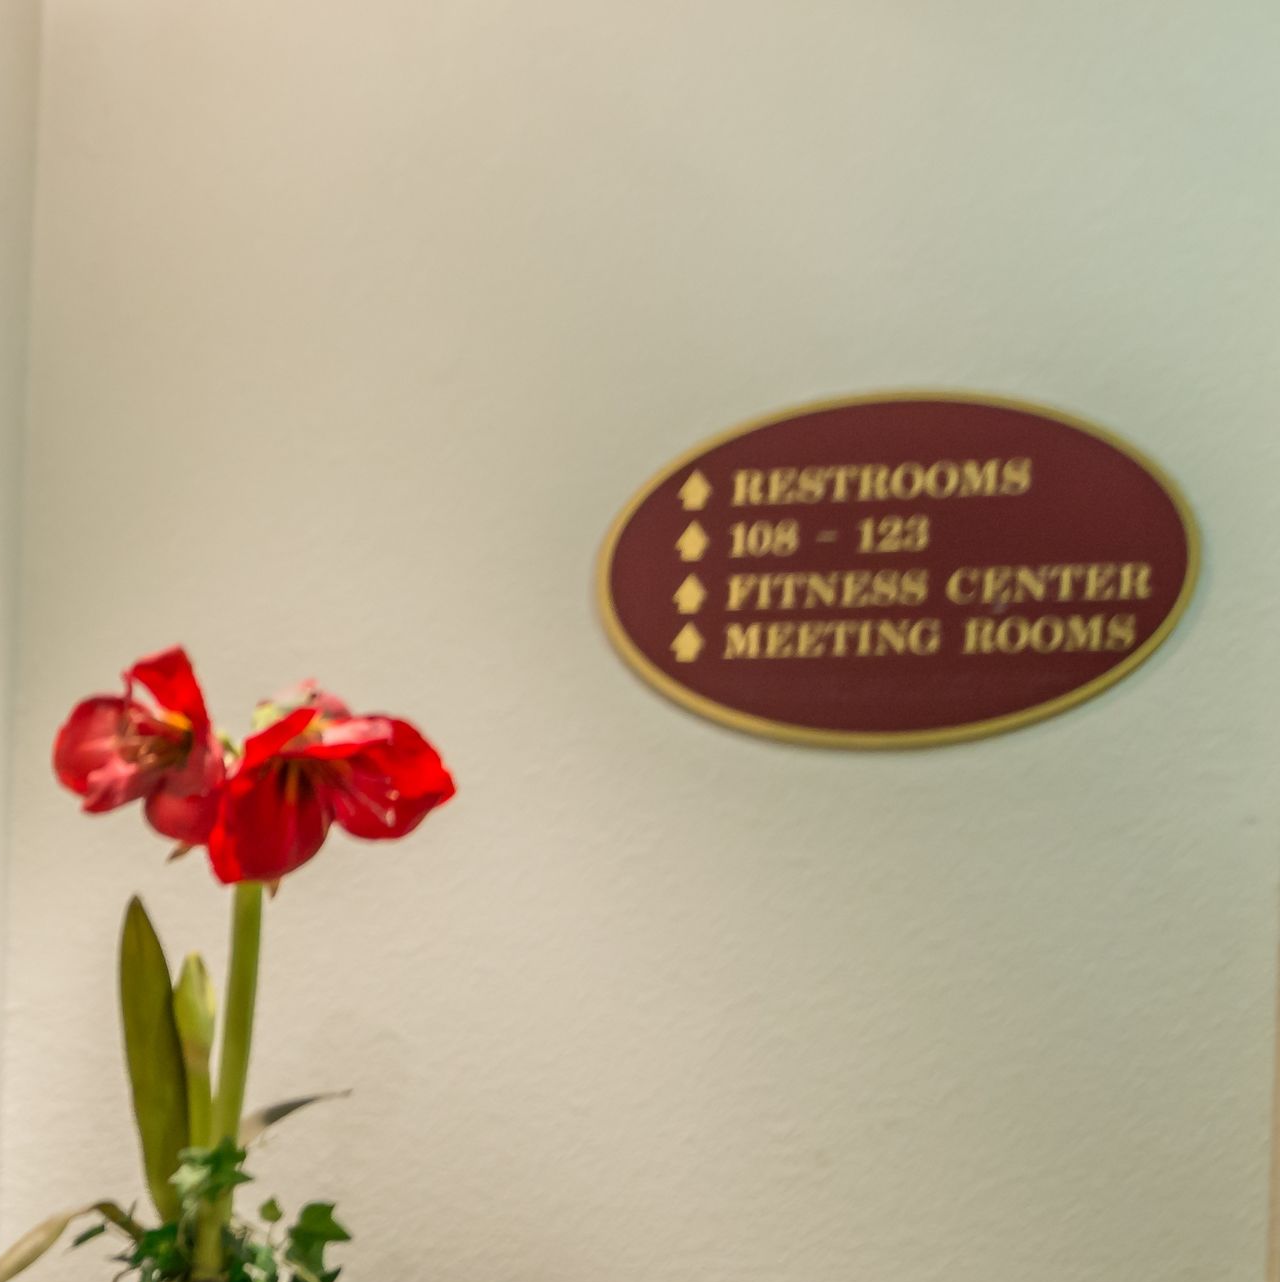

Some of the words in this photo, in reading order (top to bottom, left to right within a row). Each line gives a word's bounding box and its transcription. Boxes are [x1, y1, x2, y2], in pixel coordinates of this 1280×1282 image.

[730, 457, 1033, 507] RESTROOMS
[728, 519, 800, 559] 108
[856, 514, 930, 554] 123
[724, 568, 929, 611] FITNESS
[946, 562, 1152, 605] CENTER
[722, 618, 940, 660] MEETING
[962, 614, 1137, 655] ROOMS
